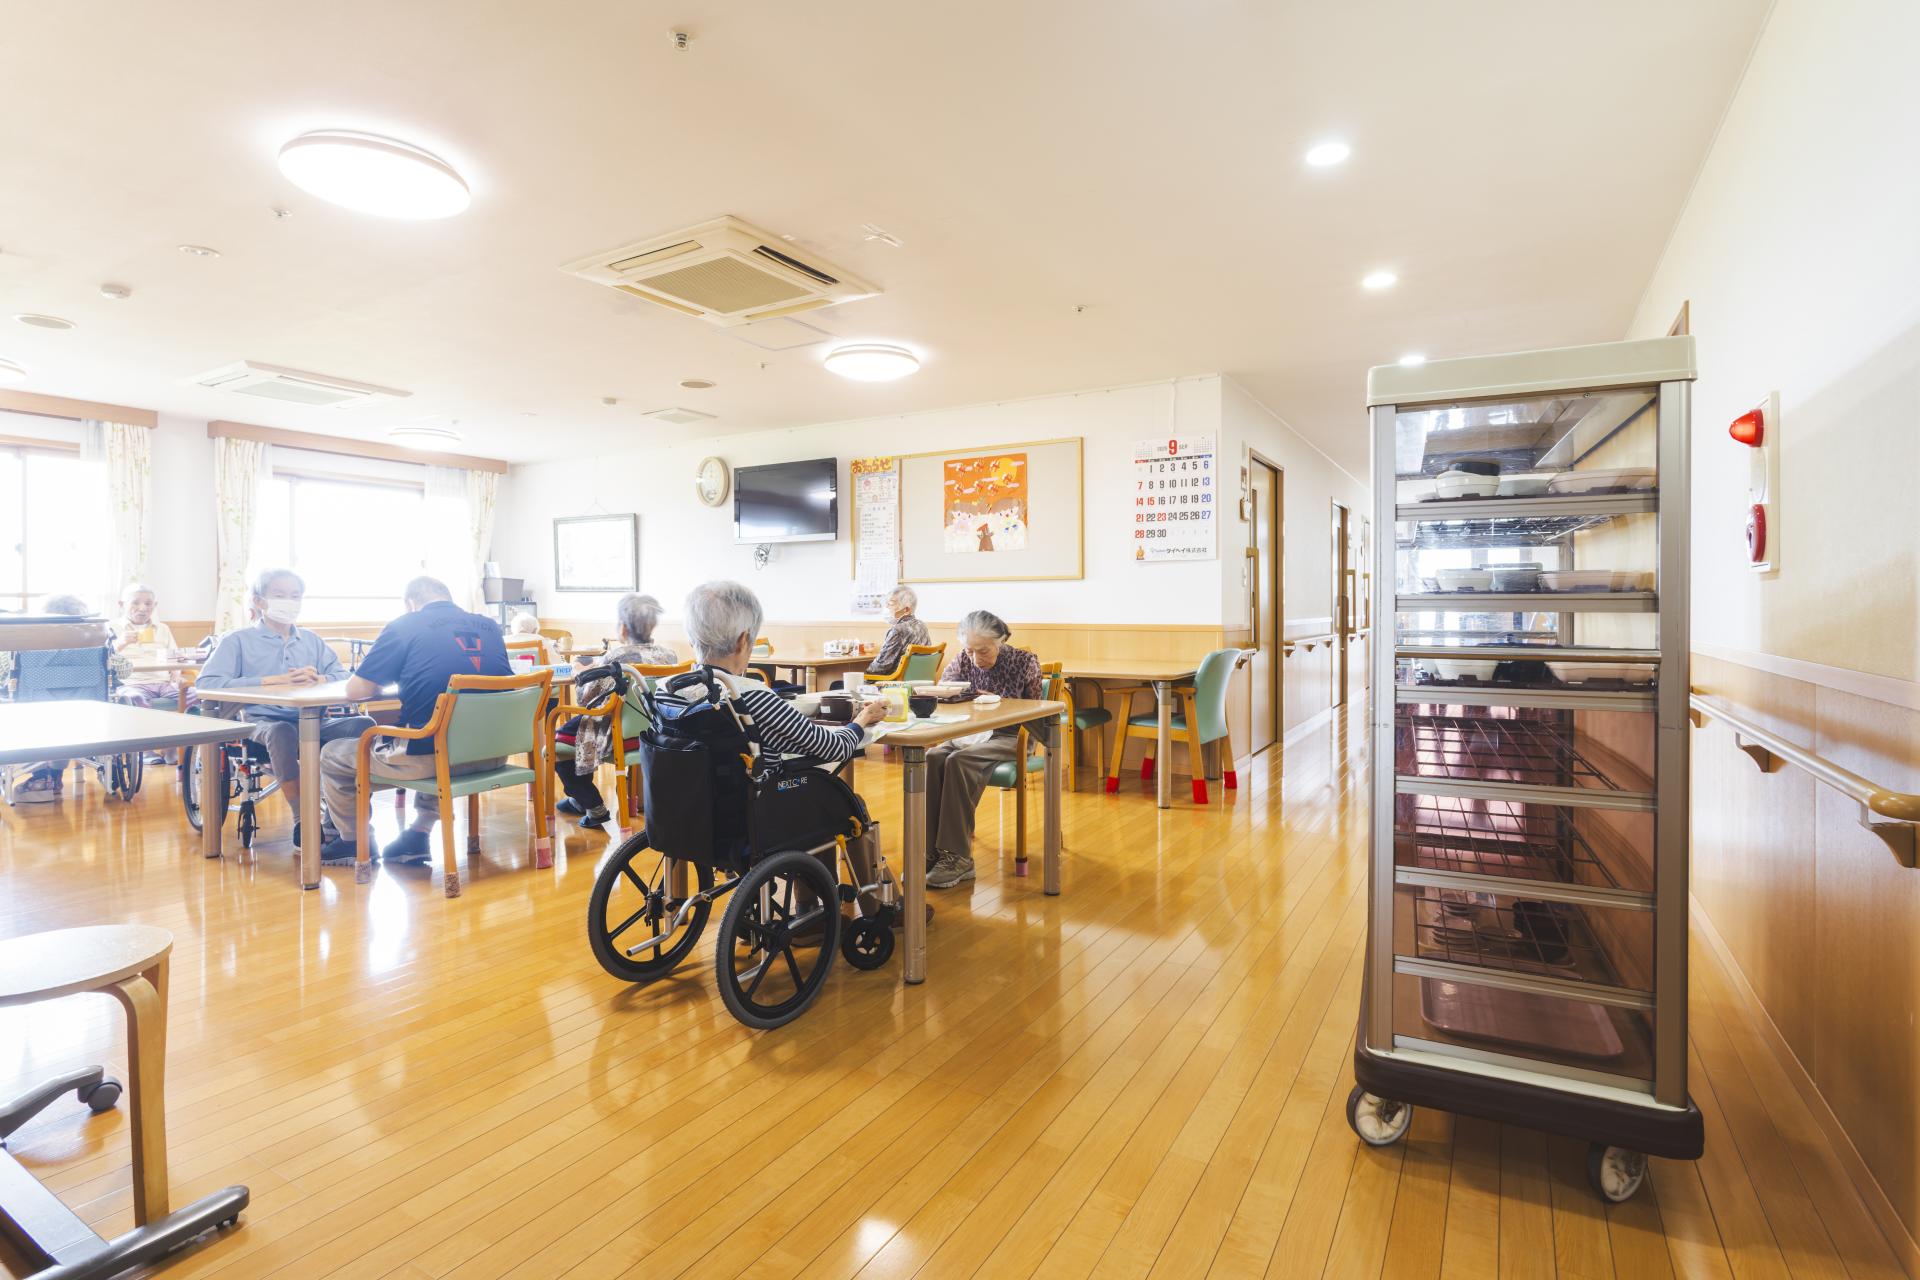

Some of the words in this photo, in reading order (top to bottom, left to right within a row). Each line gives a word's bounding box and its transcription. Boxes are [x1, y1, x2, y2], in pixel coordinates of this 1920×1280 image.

[1168, 440, 1178, 455] 9
[1150, 465, 1153, 473] 1
[1160, 464, 1164, 472] 2
[1171, 463, 1175, 471] 3
[1182, 462, 1186, 470] 4
[1193, 461, 1197, 469] 5
[1204, 461, 1208, 469] 6
[1149, 481, 1153, 489] 8
[1170, 480, 1176, 488] 10
[1181, 479, 1187, 487] 11
[1192, 478, 1198, 486] 12
[1203, 477, 1210, 485] 13
[1136, 498, 1144, 506] 14
[1148, 497, 1154, 505] 15
[1159, 497, 1165, 505] 16
[1170, 496, 1176, 504] 17
[1180, 495, 1187, 503] 18
[1192, 495, 1198, 503] 19
[1202, 494, 1211, 502] 20
[1136, 514, 1144, 522] 21
[1147, 514, 1155, 522] 22
[1157, 513, 1166, 521] 23
[1179, 512, 1188, 520] 25
[1190, 511, 1199, 519] 26
[1202, 511, 1211, 519] 27
[1135, 530, 1144, 538] 28
[1147, 530, 1155, 538] 29
